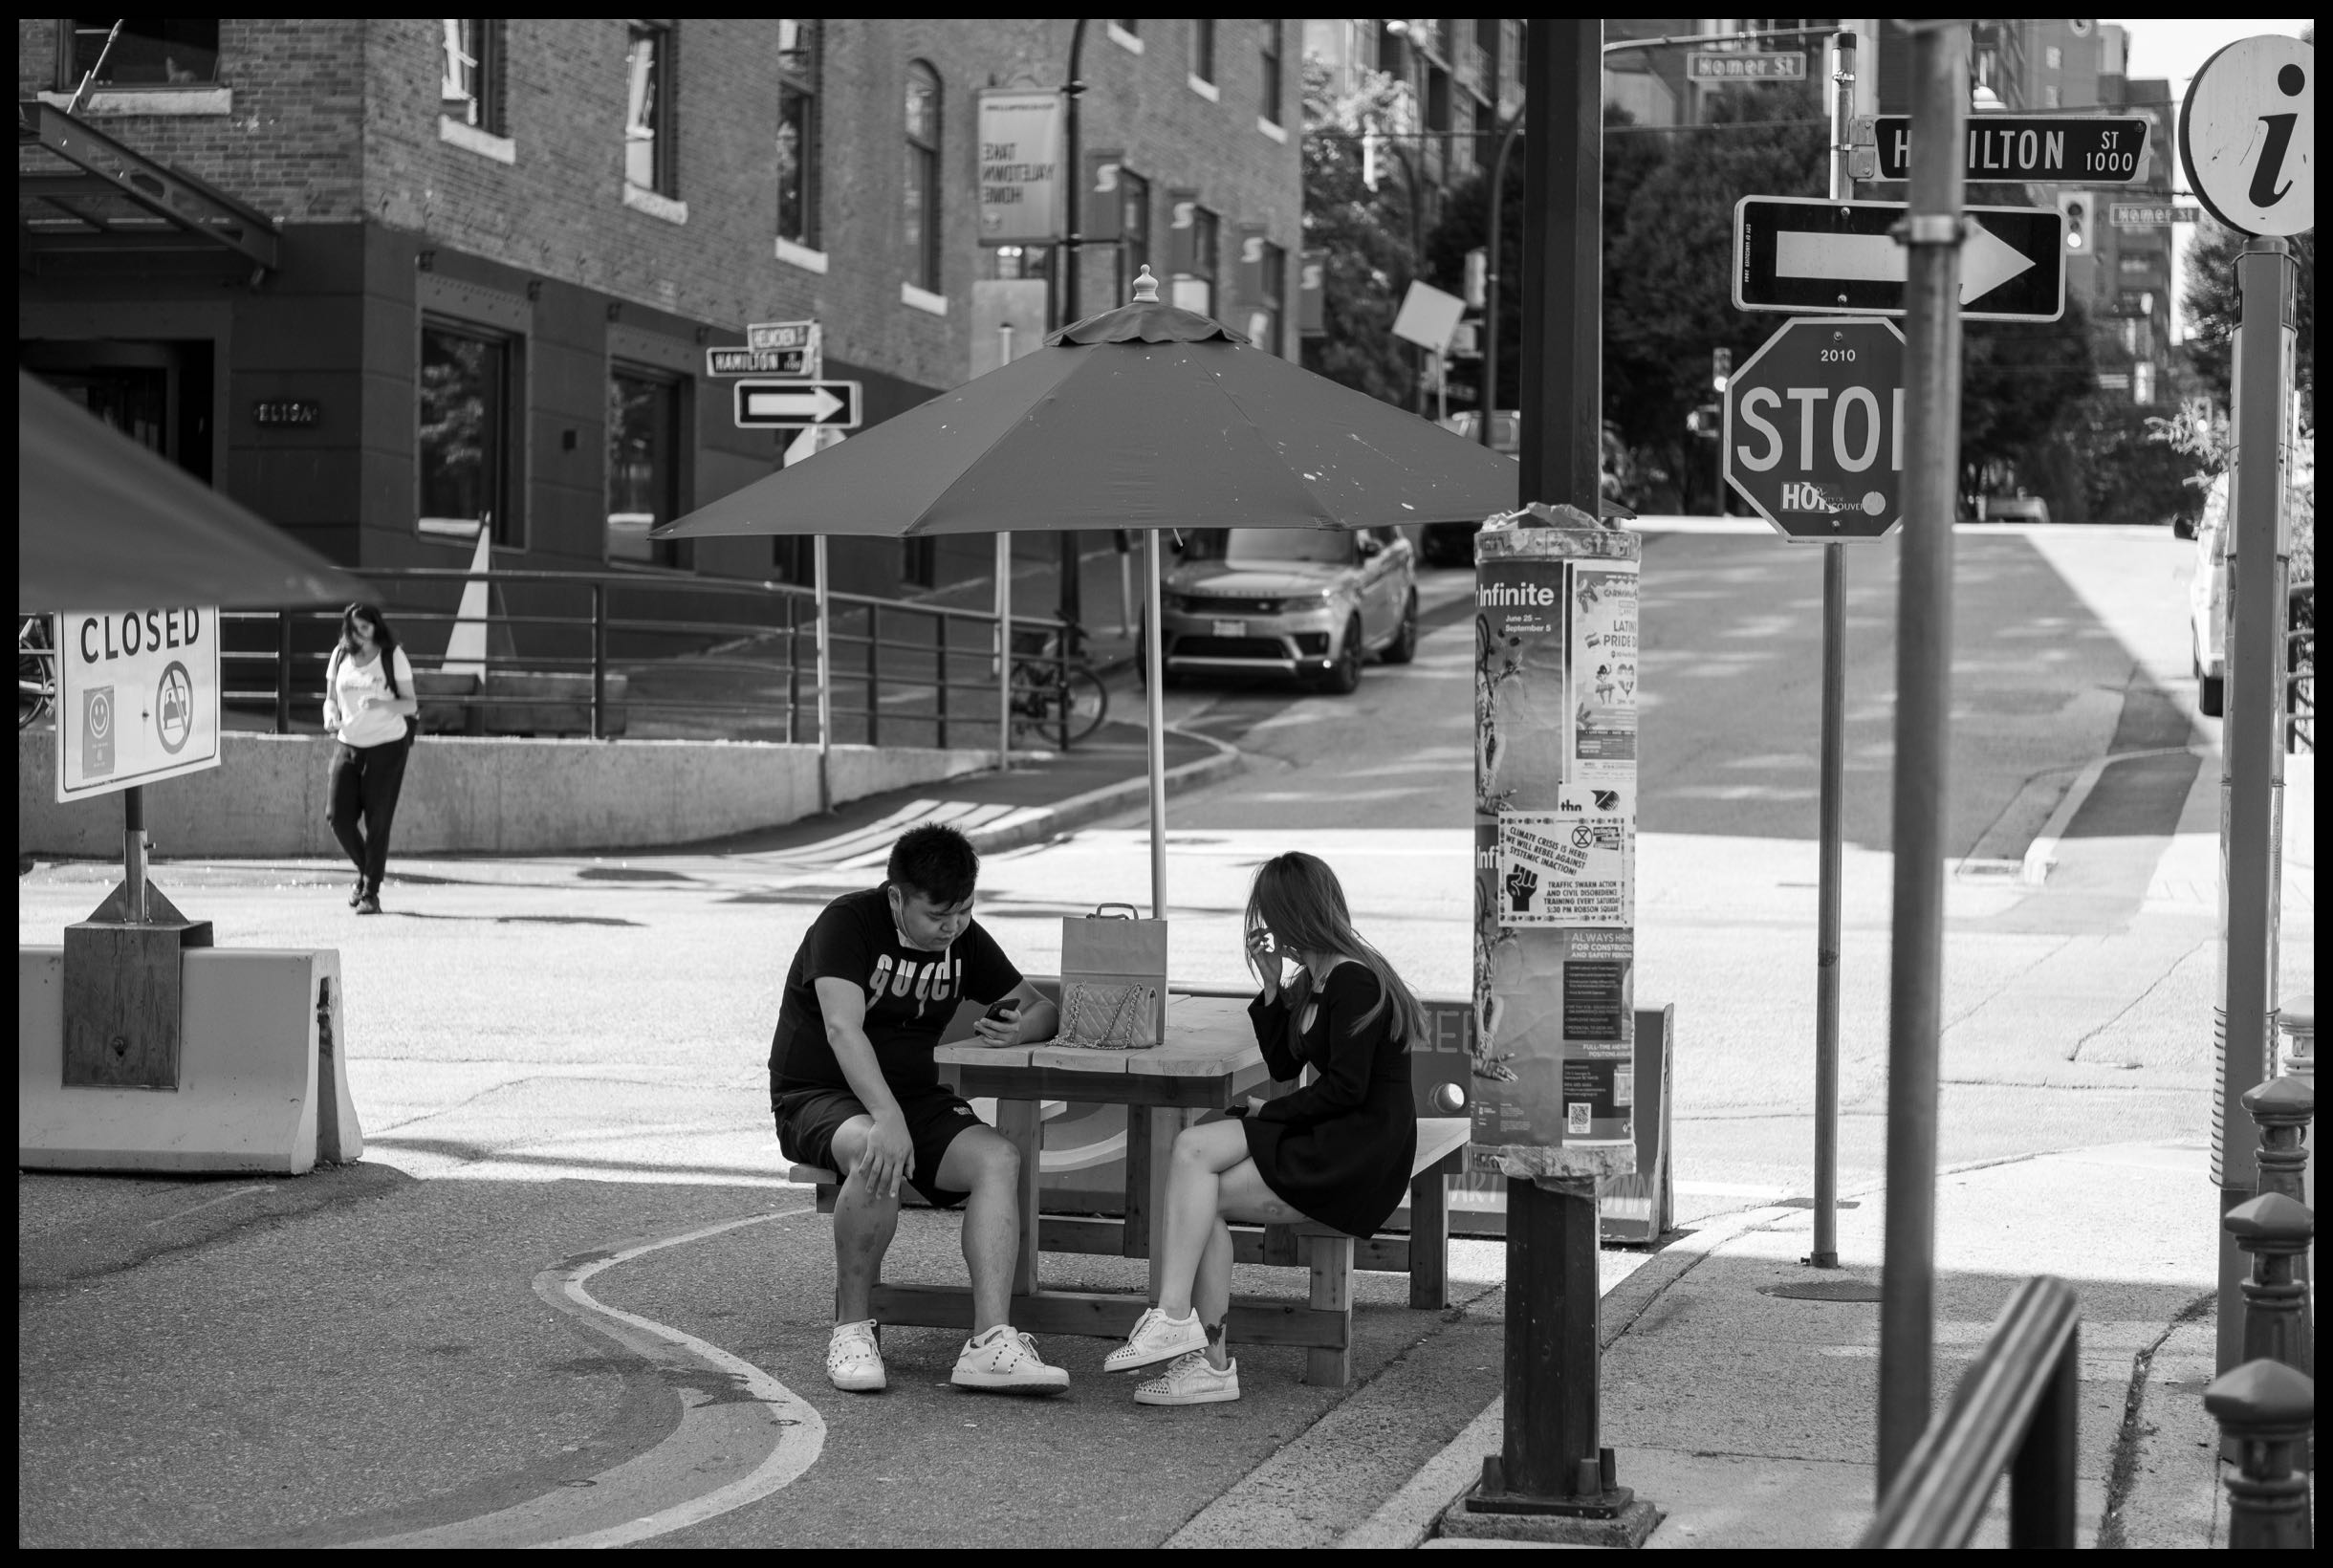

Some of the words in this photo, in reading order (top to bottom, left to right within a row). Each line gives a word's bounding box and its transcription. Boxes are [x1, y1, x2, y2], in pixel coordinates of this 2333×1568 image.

[1698, 57, 1767, 76] Homer
[1774, 57, 1795, 76] St
[1894, 129, 2064, 169] HILTON
[2101, 131, 2120, 149] ST
[2086, 152, 2134, 171] 1000
[2118, 207, 2172, 223] Homer
[715, 353, 779, 371] HAMILTON
[1821, 349, 1856, 362] 2010
[1737, 386, 1905, 472] STO
[1479, 582, 1555, 607] Infinite
[80, 605, 199, 664] CLOSED
[1505, 624, 1544, 633] September
[1603, 635, 1631, 647] PRIDE
[1506, 834, 1516, 844] WE
[1516, 838, 1532, 851] WILL
[1534, 843, 1554, 859] REBEL
[1555, 852, 1586, 869] AGAINST
[1510, 826, 1537, 842] CLIMATE
[1537, 837, 1559, 850] CRISIS
[1559, 844, 1567, 853] IS
[1568, 847, 1588, 860] HERE!
[1509, 845, 1539, 863] SYSTEMIC
[1540, 856, 1578, 877] INACTION!
[1571, 932, 1614, 943] ALWAYS
[865, 953, 962, 1017] GUCCI
